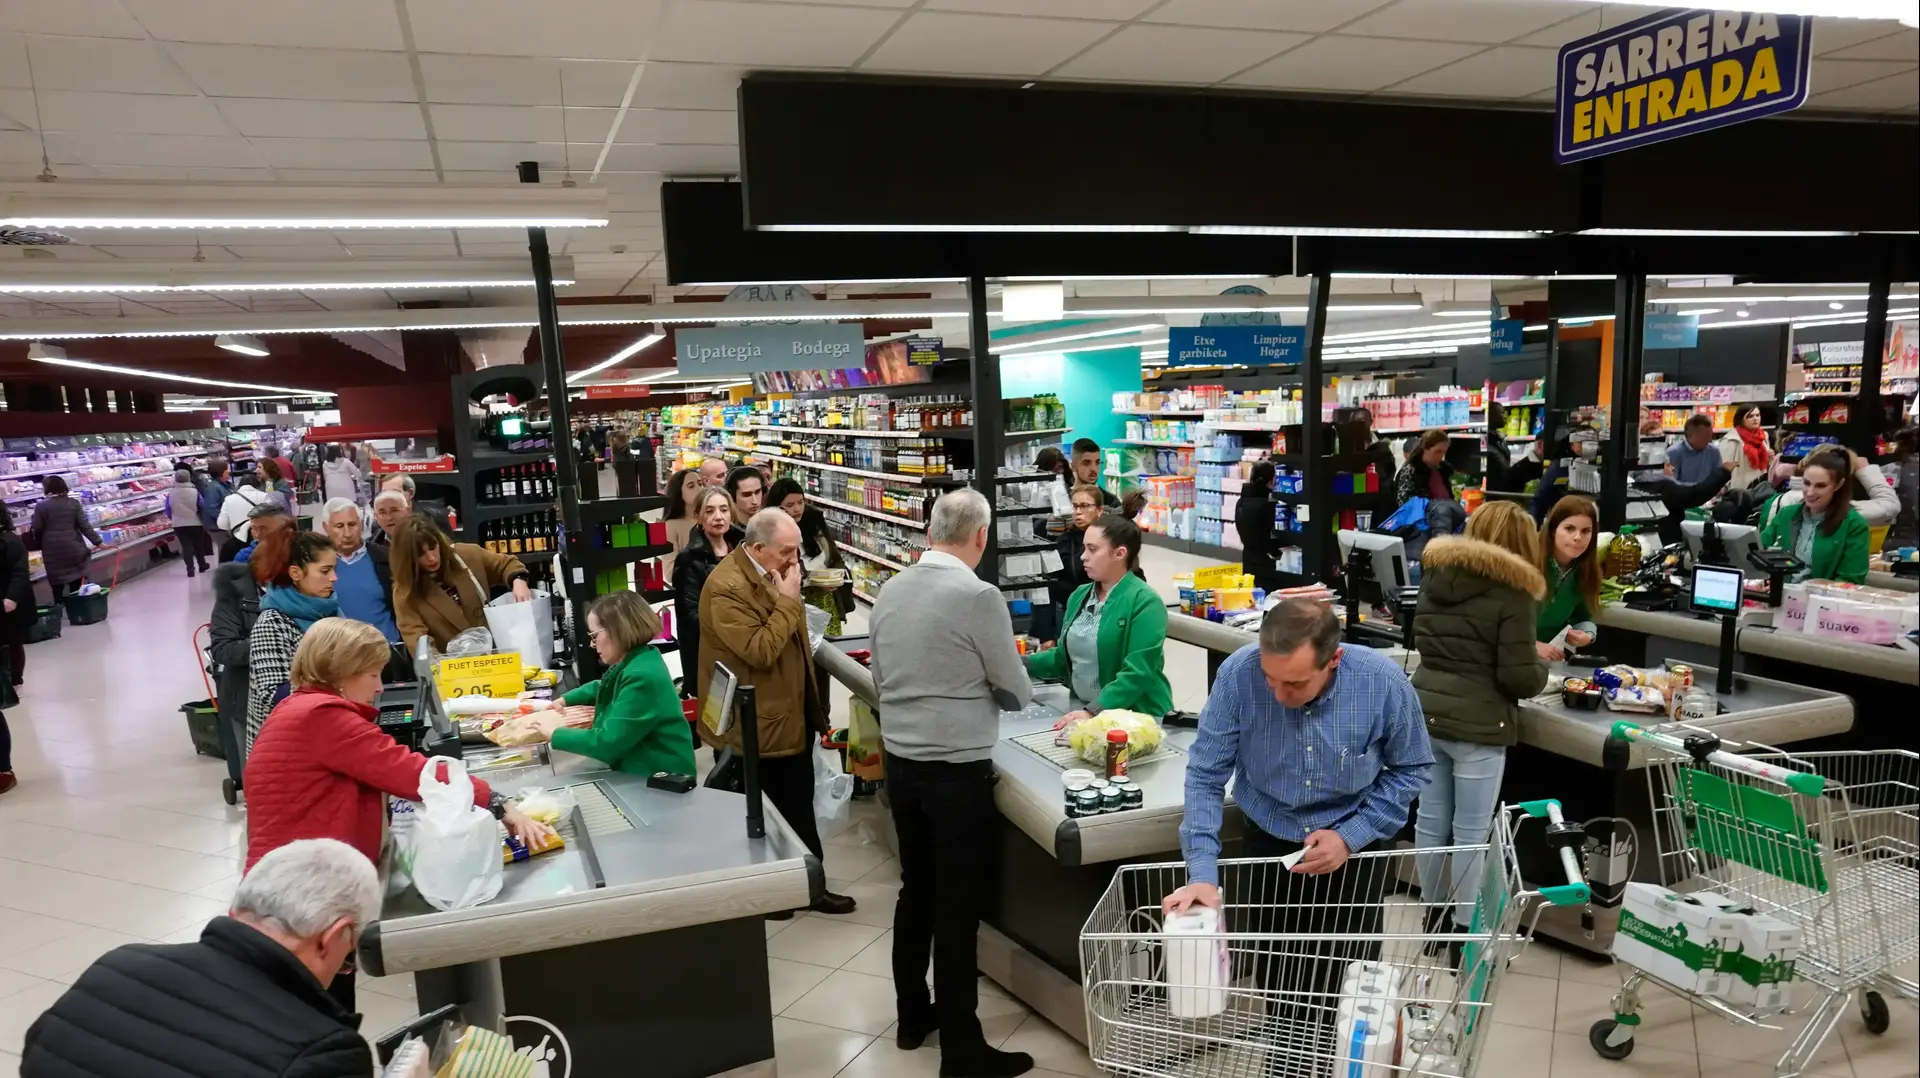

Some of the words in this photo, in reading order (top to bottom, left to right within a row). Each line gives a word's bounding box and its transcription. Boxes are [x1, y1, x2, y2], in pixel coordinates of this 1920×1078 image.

[1574, 11, 1780, 97] SARRERA
[1573, 47, 1783, 144] ENTRADA
[1193, 335, 1216, 346] Etxe
[1253, 334, 1297, 347] Limpieza
[686, 343, 762, 363] Upategia
[792, 340, 851, 358] Bodega
[1179, 348, 1227, 361] garbiketa
[1260, 347, 1290, 359] Hogar
[1819, 621, 1860, 634] suave
[448, 661, 471, 671] FUET
[473, 657, 514, 668] ESPETEC
[453, 684, 493, 698] 205
